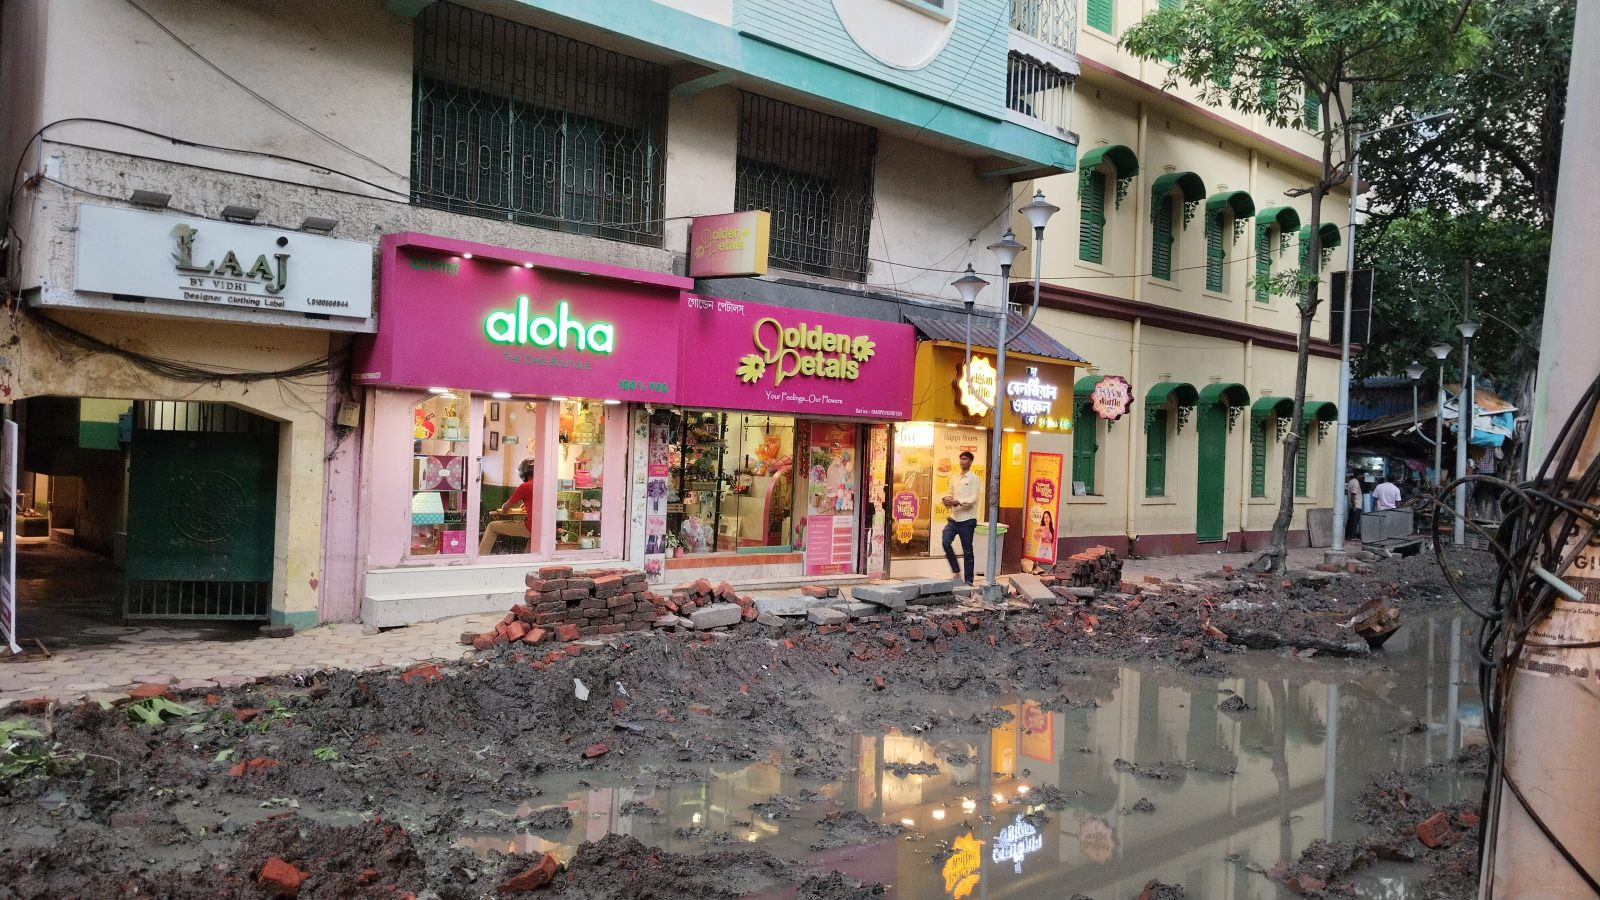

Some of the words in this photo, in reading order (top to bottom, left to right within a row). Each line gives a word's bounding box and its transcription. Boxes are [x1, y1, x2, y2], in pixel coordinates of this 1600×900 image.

[190, 278, 204, 286] BY
[212, 280, 247, 291] VIDHI
[183, 291, 221, 301] Designer
[227, 296, 260, 307] Clothing
[264, 299, 285, 308] Label
[483, 295, 614, 354] aloha
[753, 317, 851, 364] Golden
[774, 345, 860, 387] Petals
[649, 382, 669, 393] VEG
[765, 391, 781, 400] Your
